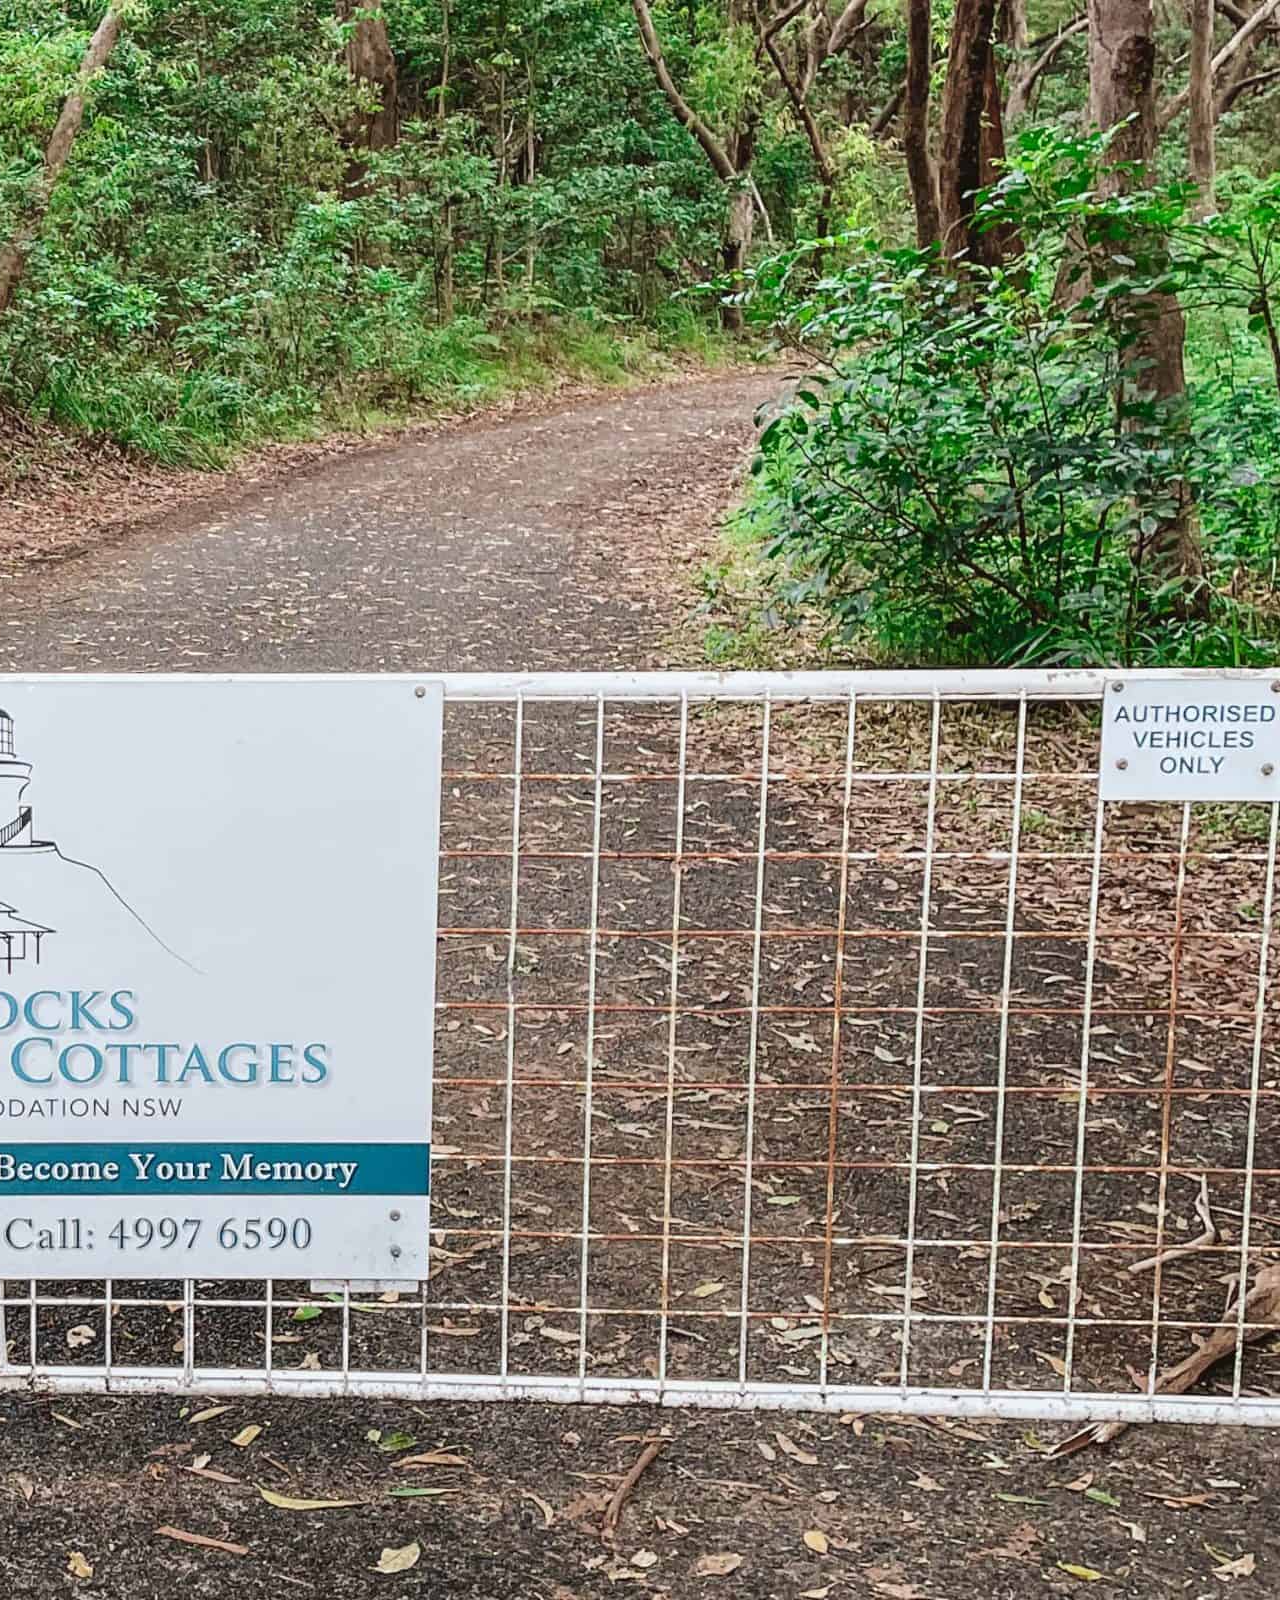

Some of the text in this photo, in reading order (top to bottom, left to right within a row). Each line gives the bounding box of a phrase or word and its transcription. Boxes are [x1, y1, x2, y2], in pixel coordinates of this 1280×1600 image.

[1114, 705, 1276, 723] AUTHORISED
[1133, 730, 1254, 748] VEHICLES
[1160, 756, 1224, 774] ONLY
[122, 1098, 183, 1117] NSW
[128, 1153, 211, 1181] Your
[220, 1153, 358, 1188] Memory
[4, 1217, 312, 1251] Call: 4997 6590
